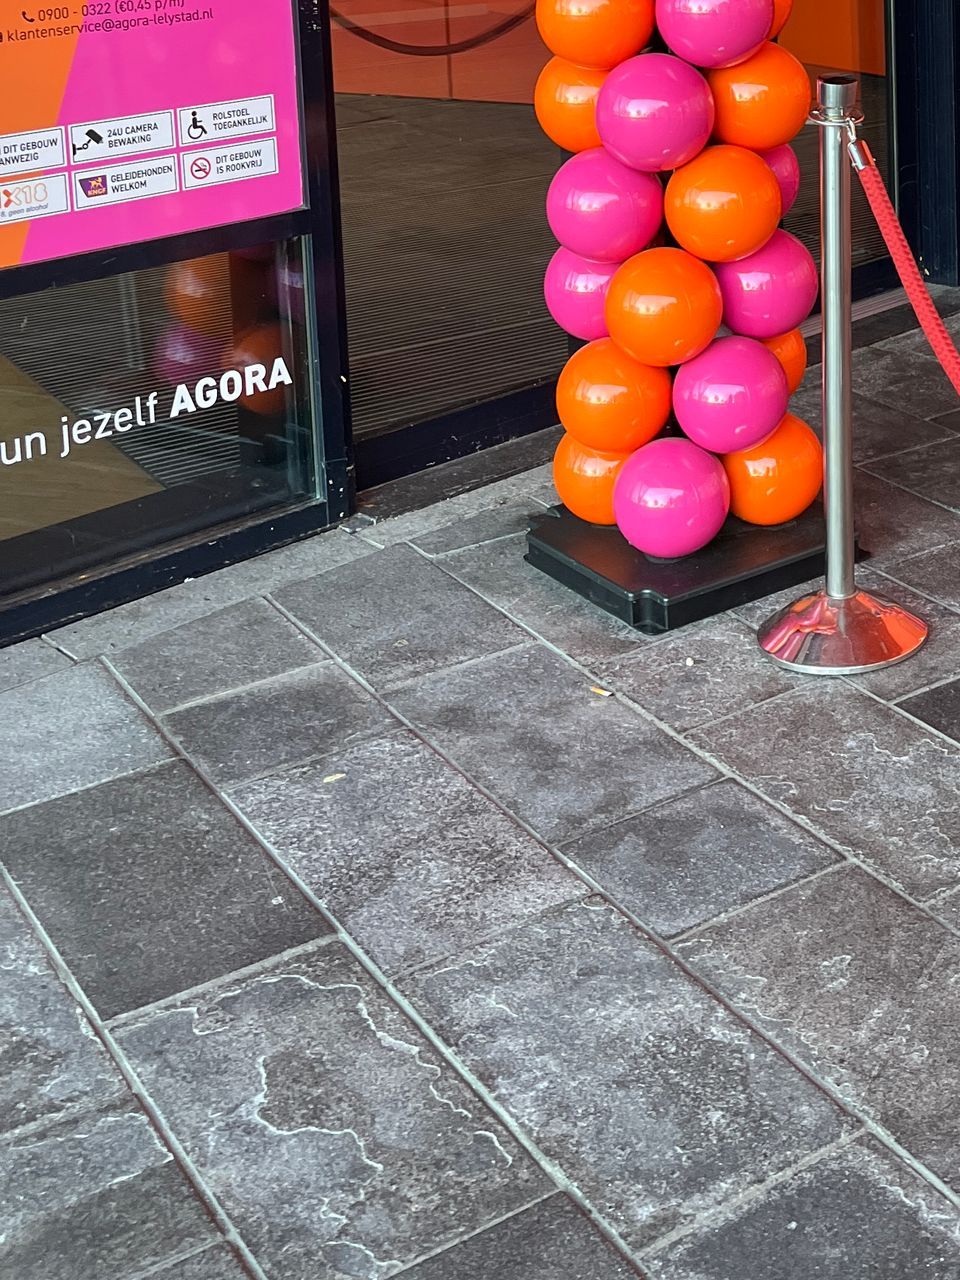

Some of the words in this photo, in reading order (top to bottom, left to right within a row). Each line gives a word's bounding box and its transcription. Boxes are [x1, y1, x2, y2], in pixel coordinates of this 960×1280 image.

[38, 7, 69, 21] 0900
[82, 2, 111, 17] 0322
[7, 7, 214, 41] klantenservice@agora-lelystad.nl
[212, 108, 250, 121] ROLSTOEL
[107, 128, 123, 138] 24U
[125, 122, 158, 135] CAMERA
[213, 115, 268, 131] TOEGANKELIJK
[3, 144, 18, 154] DIT
[20, 138, 58, 152] GEBOUW
[108, 134, 151, 148] BEWAKING
[216, 155, 228, 164] DIT
[230, 149, 262, 162] GEBOUW
[110, 165, 173, 183] GELEIDEHONDEN
[216, 166, 224, 174] IS
[226, 159, 263, 172] ROOKVRIJ
[0, 182, 48, 208] X18
[111, 180, 147, 194] WELKOM
[60, 391, 158, 458] jezelf
[170, 357, 293, 418] AGORA
